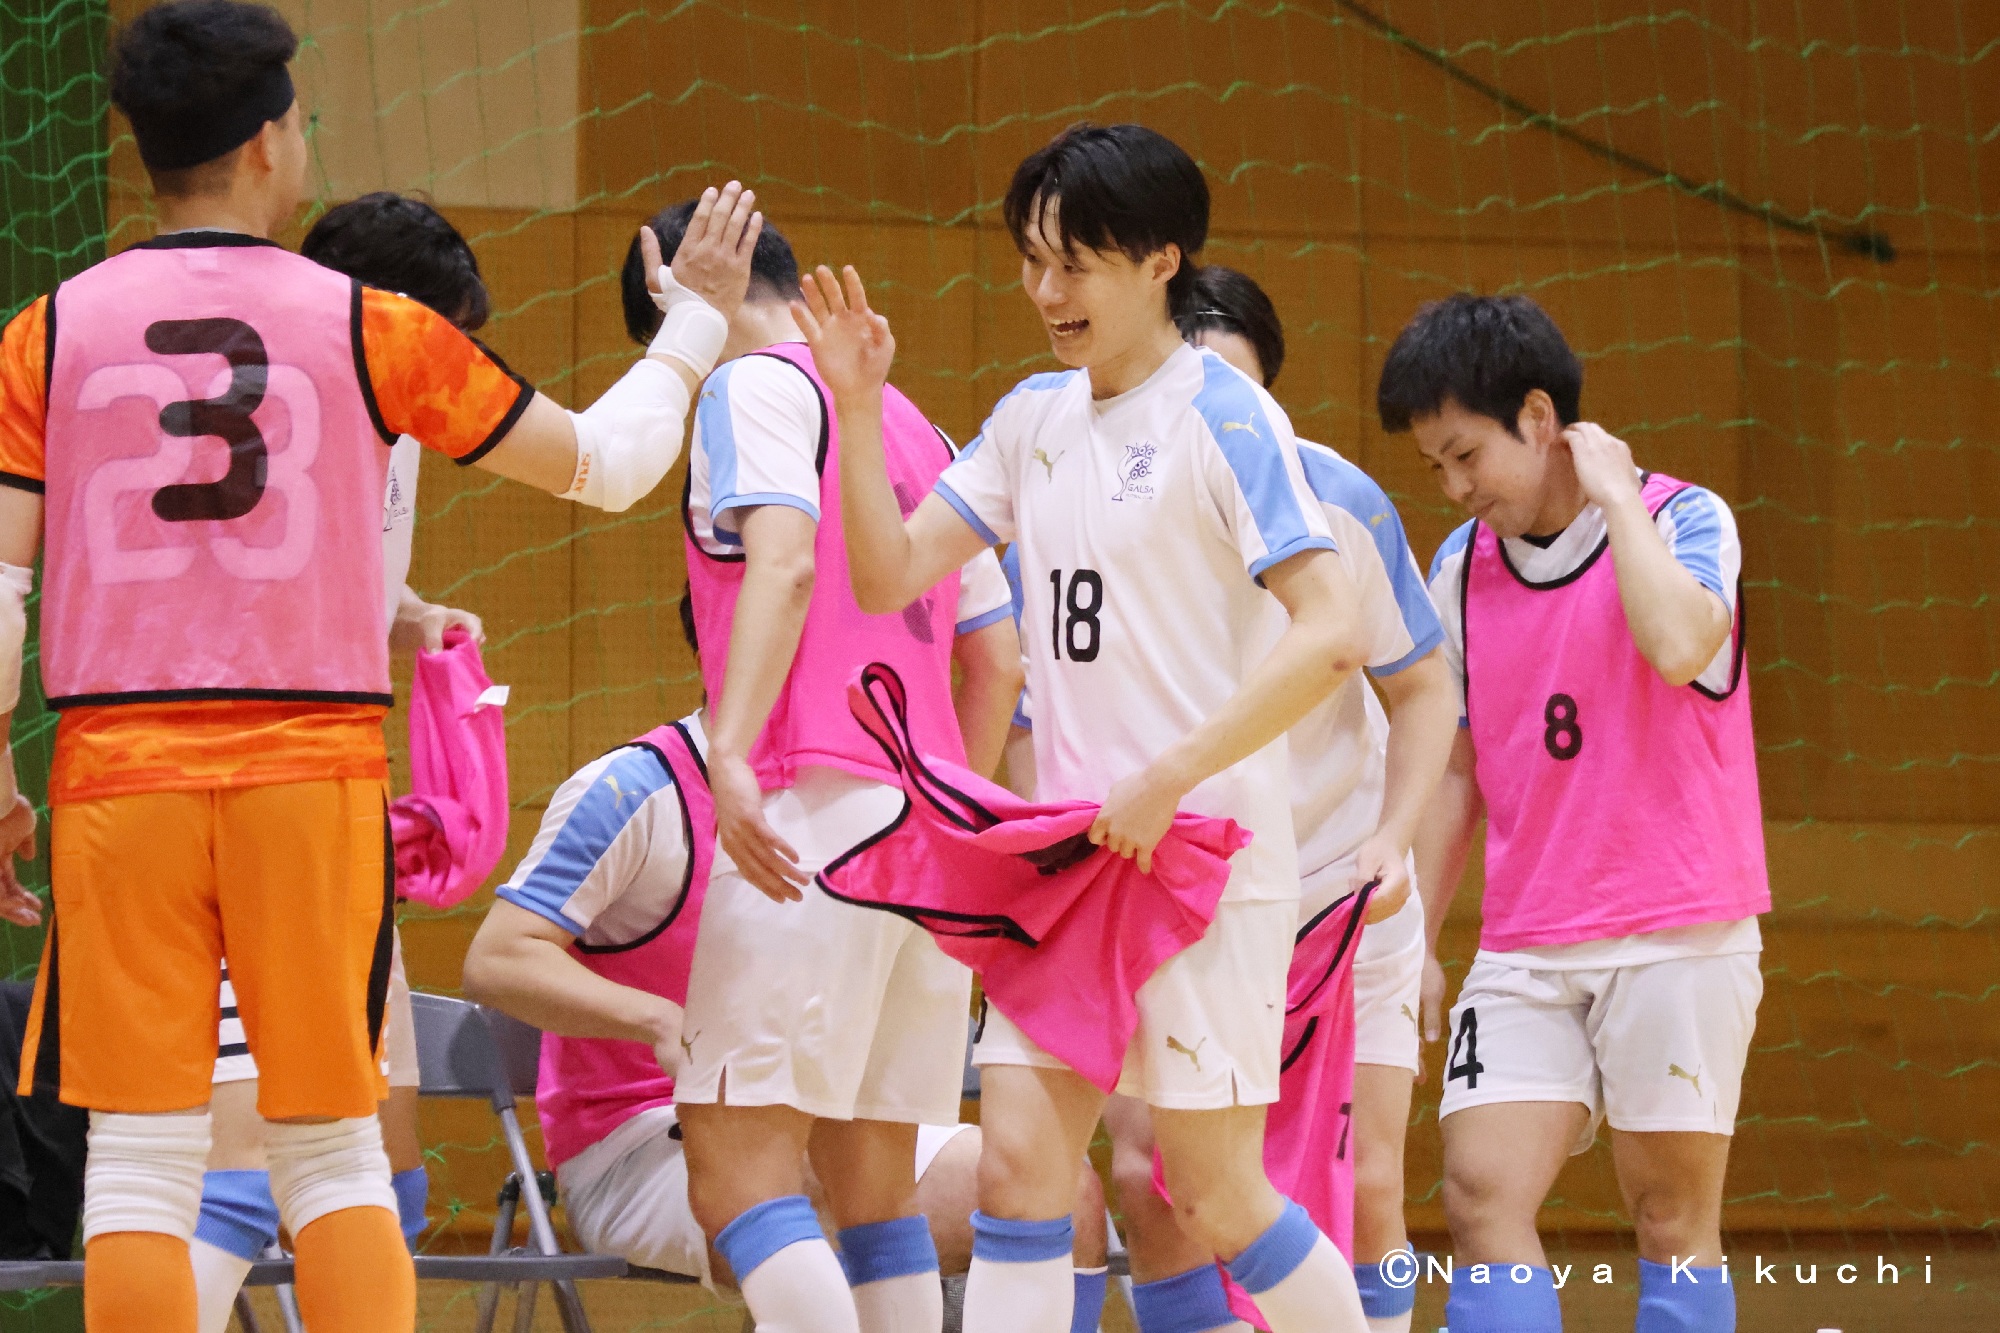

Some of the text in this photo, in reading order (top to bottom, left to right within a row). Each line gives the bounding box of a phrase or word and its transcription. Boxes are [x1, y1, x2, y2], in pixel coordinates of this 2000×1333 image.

[144, 317, 269, 522] 3
[1127, 483, 1154, 495] GALSA
[1049, 568, 1103, 663] 18
[1544, 693, 1583, 761] 8
[1447, 1007, 1485, 1090] 4
